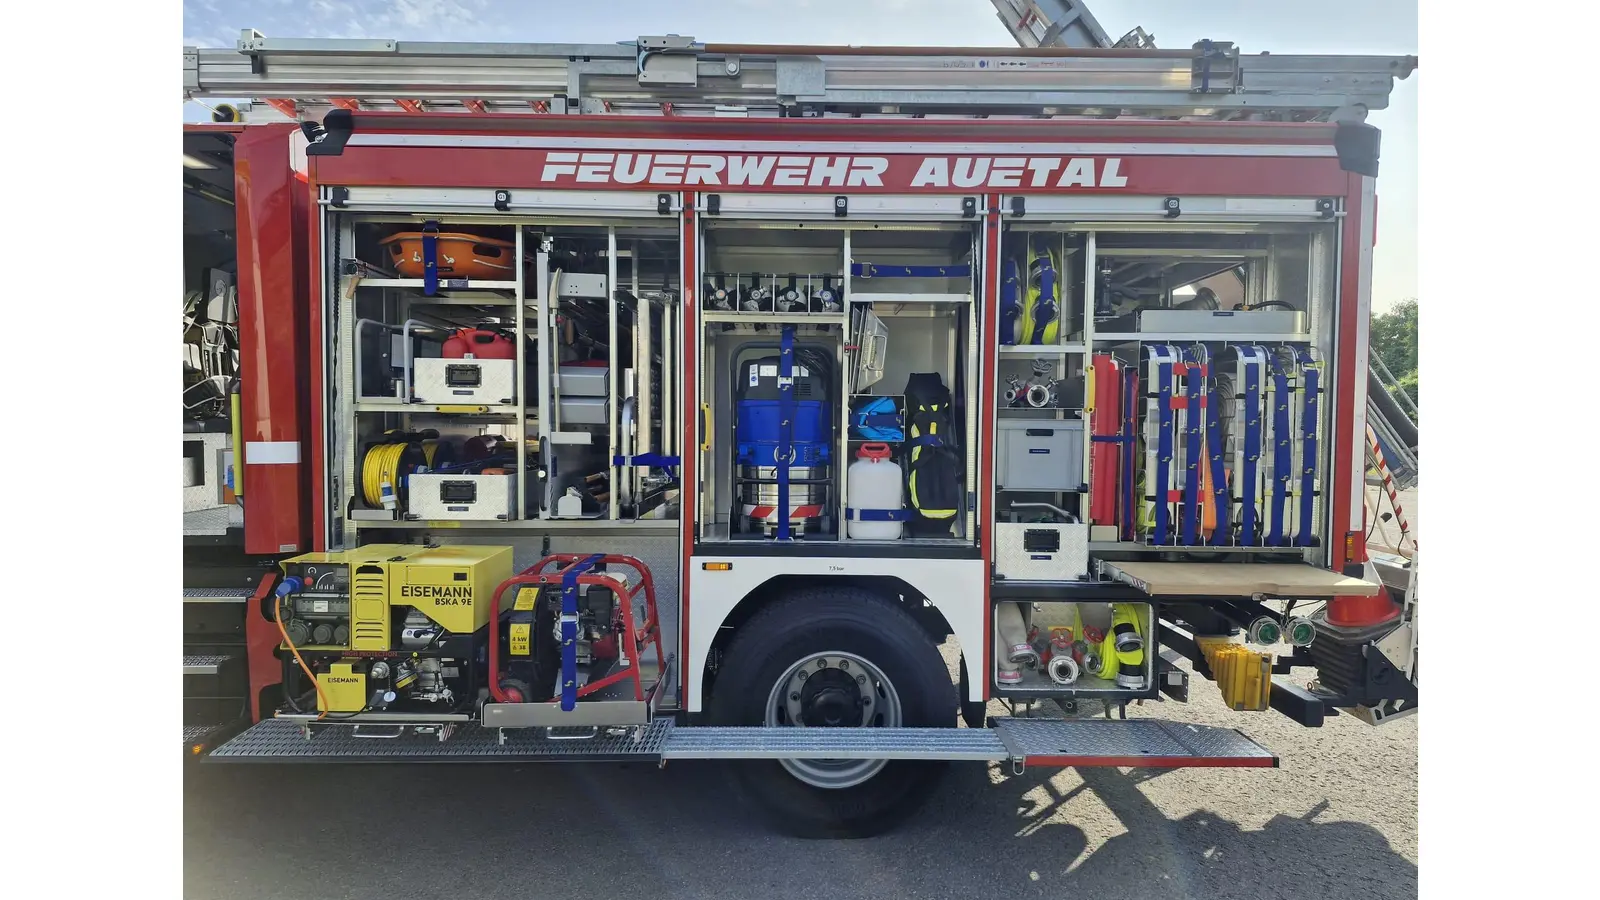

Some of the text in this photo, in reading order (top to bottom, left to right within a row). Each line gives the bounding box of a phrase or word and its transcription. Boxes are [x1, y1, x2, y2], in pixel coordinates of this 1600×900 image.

[540, 152, 1129, 188] FEUERWEHR AUETAL
[401, 586, 472, 598] EISEMANN
[435, 598, 472, 606] BSKA 9E
